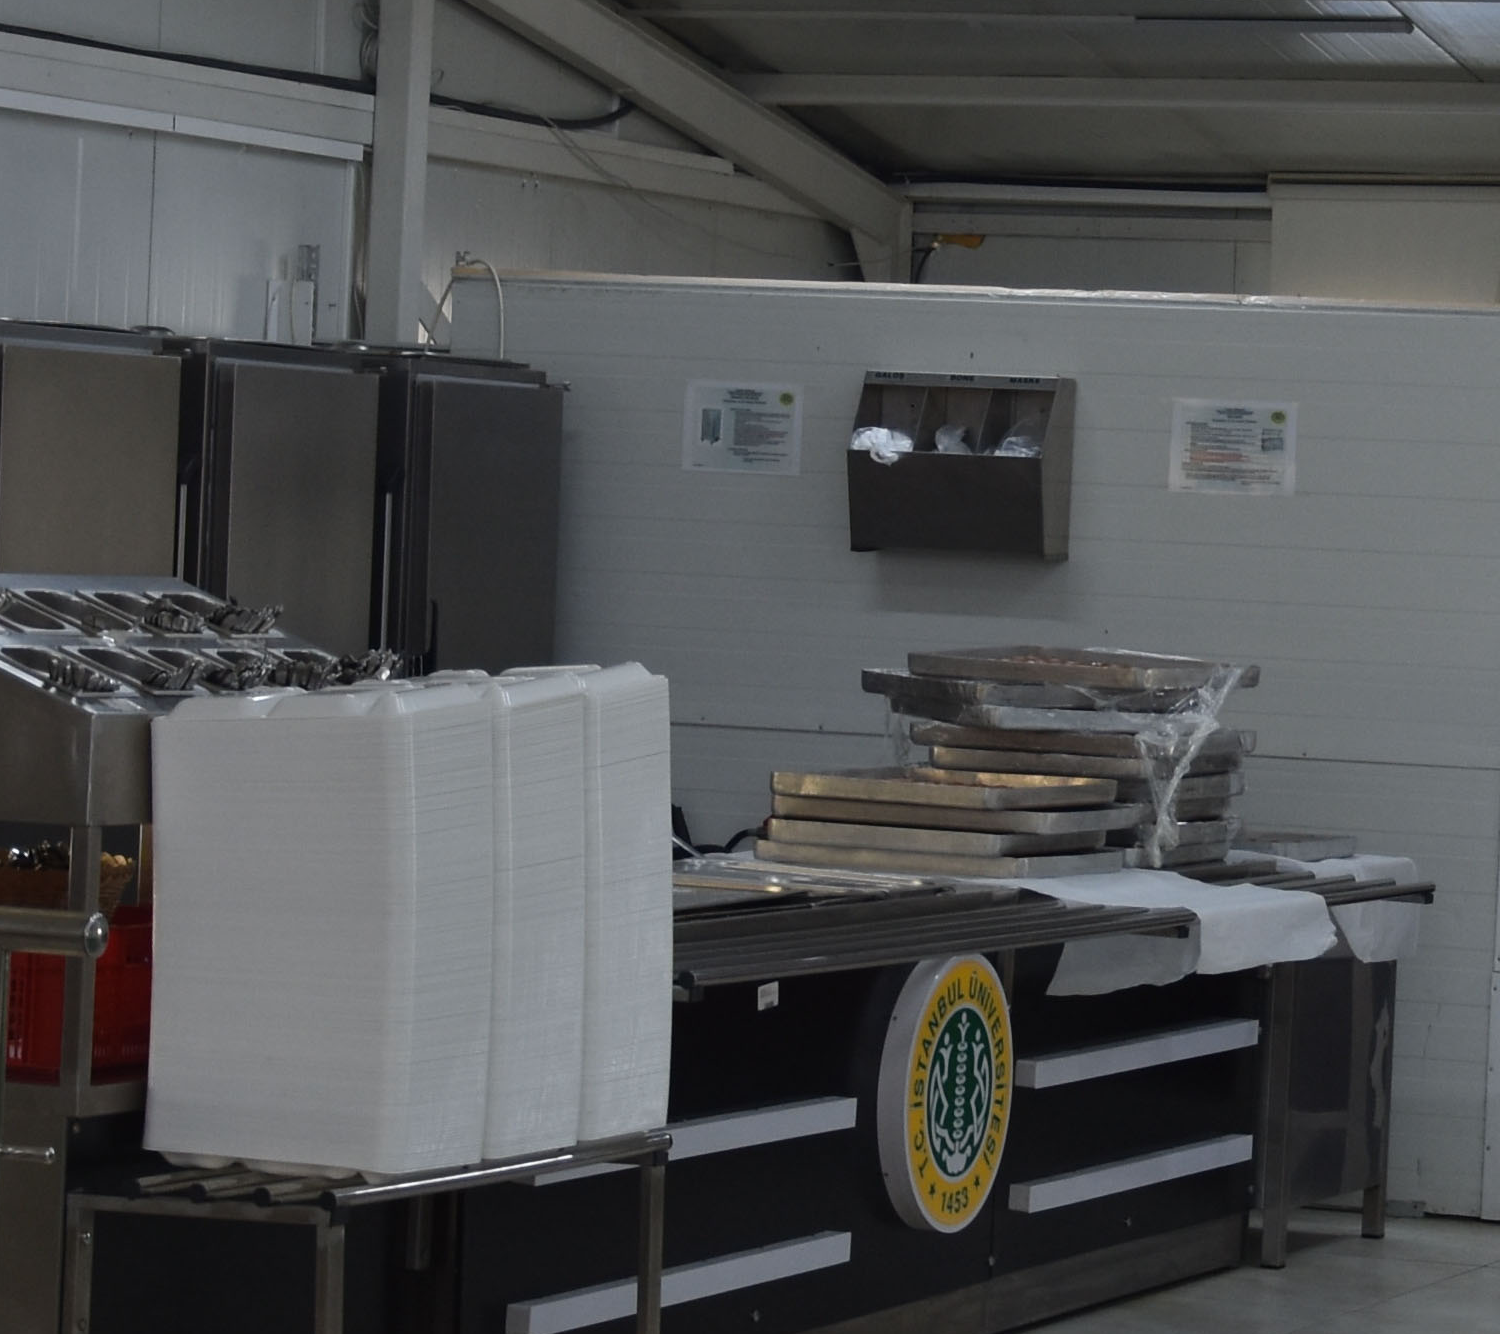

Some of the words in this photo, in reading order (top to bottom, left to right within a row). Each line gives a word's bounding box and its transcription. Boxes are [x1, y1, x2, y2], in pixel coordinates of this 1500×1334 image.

[911, 977, 965, 1107] İSTANBUL
[969, 970, 1007, 1170] ÜNİVERSİTESİ
[941, 1186, 969, 1214] 1453
